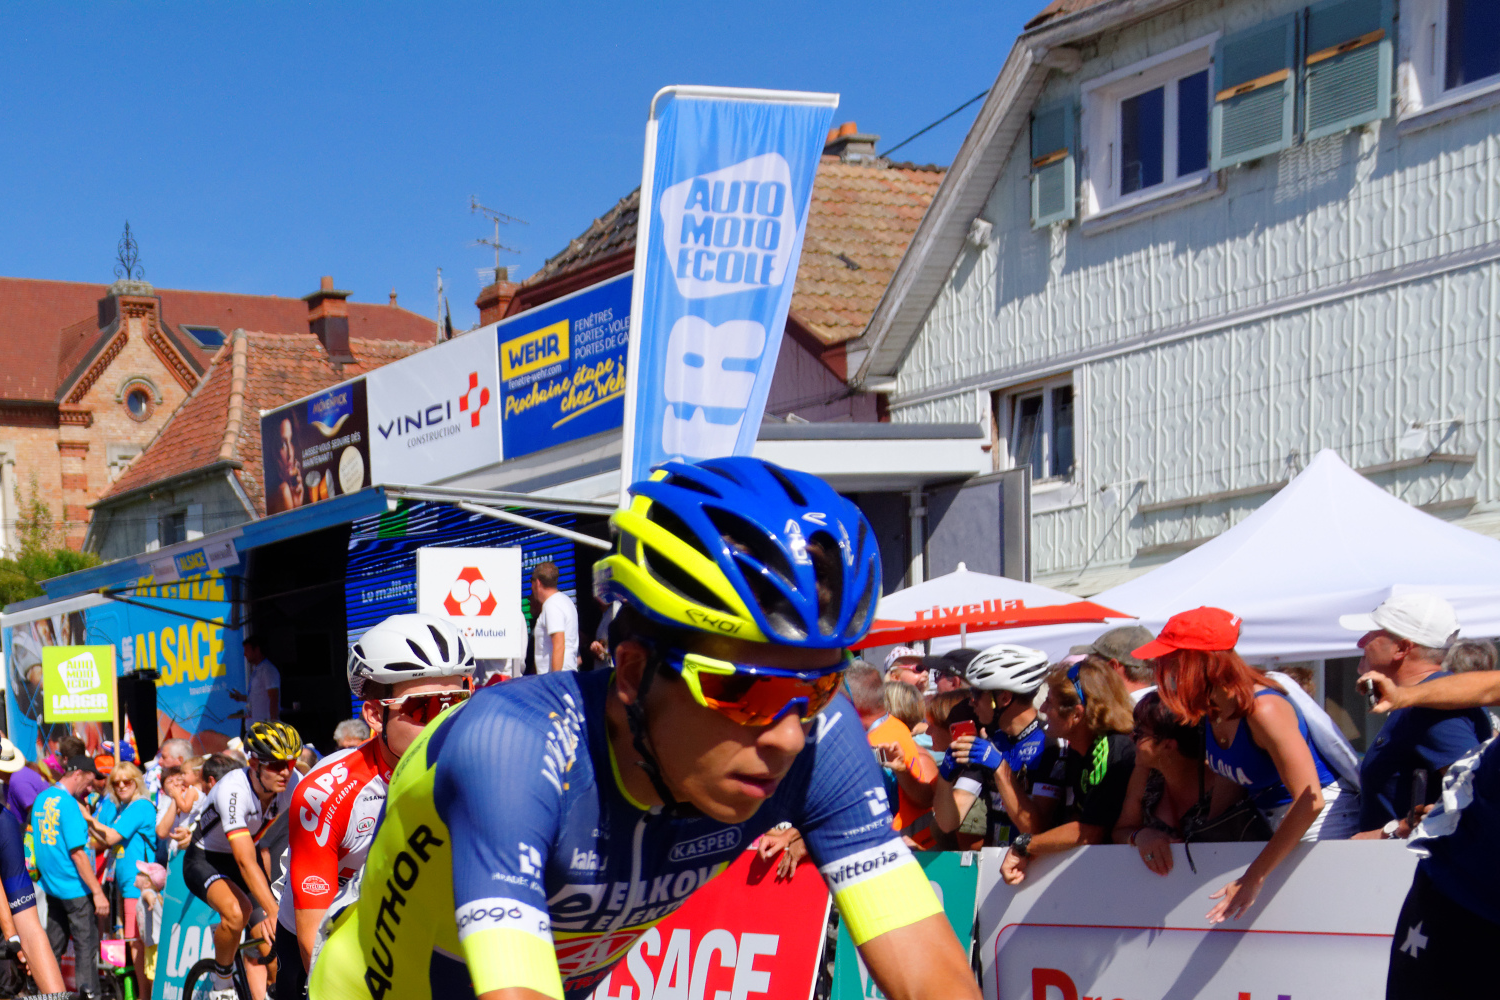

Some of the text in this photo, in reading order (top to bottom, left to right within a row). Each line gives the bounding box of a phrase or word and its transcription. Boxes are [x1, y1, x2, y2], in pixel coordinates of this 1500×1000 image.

[684, 177, 787, 218] AUTO
[680, 214, 781, 251] MOTO
[676, 247, 778, 285] ECOLE
[574, 308, 613, 332] FENÊTRES
[574, 326, 605, 346] PORTES
[574, 341, 605, 360] PORTES
[605, 337, 616, 351] DE
[508, 332, 561, 370] WEHR
[504, 357, 615, 420] Prochaine étape
[508, 363, 562, 390] fenetre-wehr.com
[561, 385, 595, 412] chez
[377, 399, 452, 441] VINCI
[406, 423, 461, 448] CONSTRUCTION
[914, 598, 1026, 622] rivella
[475, 628, 506, 637] Mutuel
[67, 660, 93, 670] AUTO
[135, 617, 227, 688] ALSACE
[67, 670, 93, 679] MOTO
[67, 680, 93, 689] ECOLE
[52, 693, 108, 709] LARGER
[299, 761, 349, 833] CAPS
[324, 784, 352, 828] FUEL CARD
[674, 831, 736, 859] KASPER
[828, 851, 899, 885] vittoria
[606, 863, 722, 911] ELKOV
[162, 981, 178, 1000] Mon
